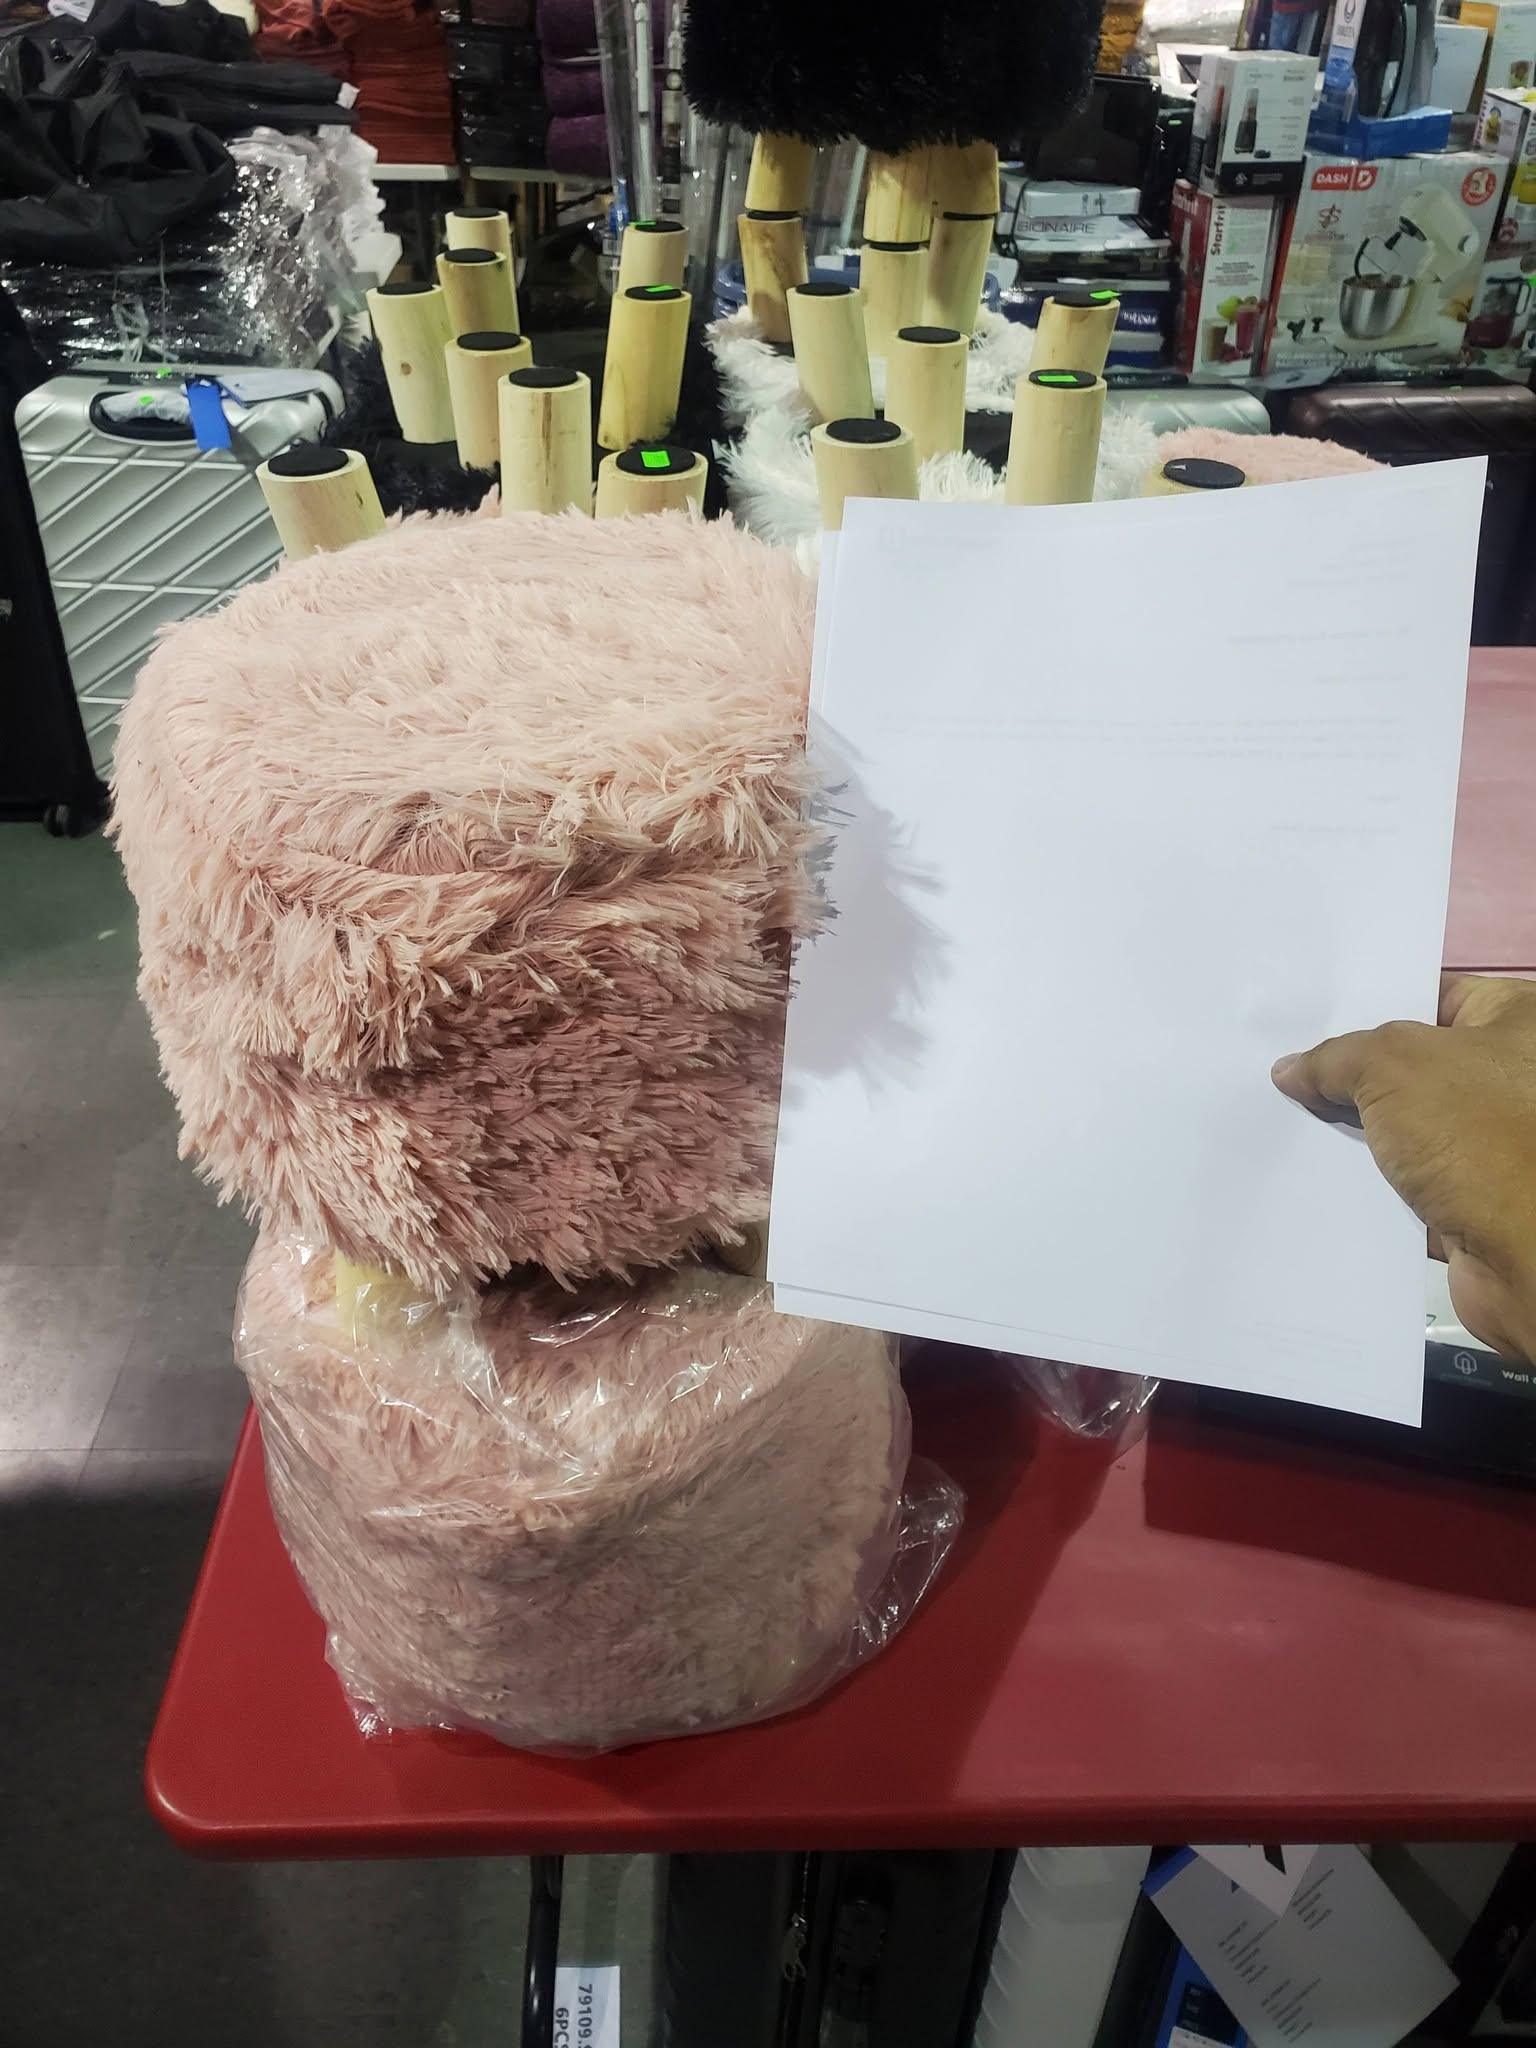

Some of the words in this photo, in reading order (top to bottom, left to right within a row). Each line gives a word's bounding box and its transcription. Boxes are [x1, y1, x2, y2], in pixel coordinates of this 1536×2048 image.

[1316, 173, 1349, 184] DASH
[1016, 221, 1097, 234] BIONAIRE
[1210, 205, 1226, 256] Starfrit
[1502, 1370, 1529, 1384] Wall
[555, 2007, 570, 2048] 6PC
[578, 1984, 593, 2048] 79109.
